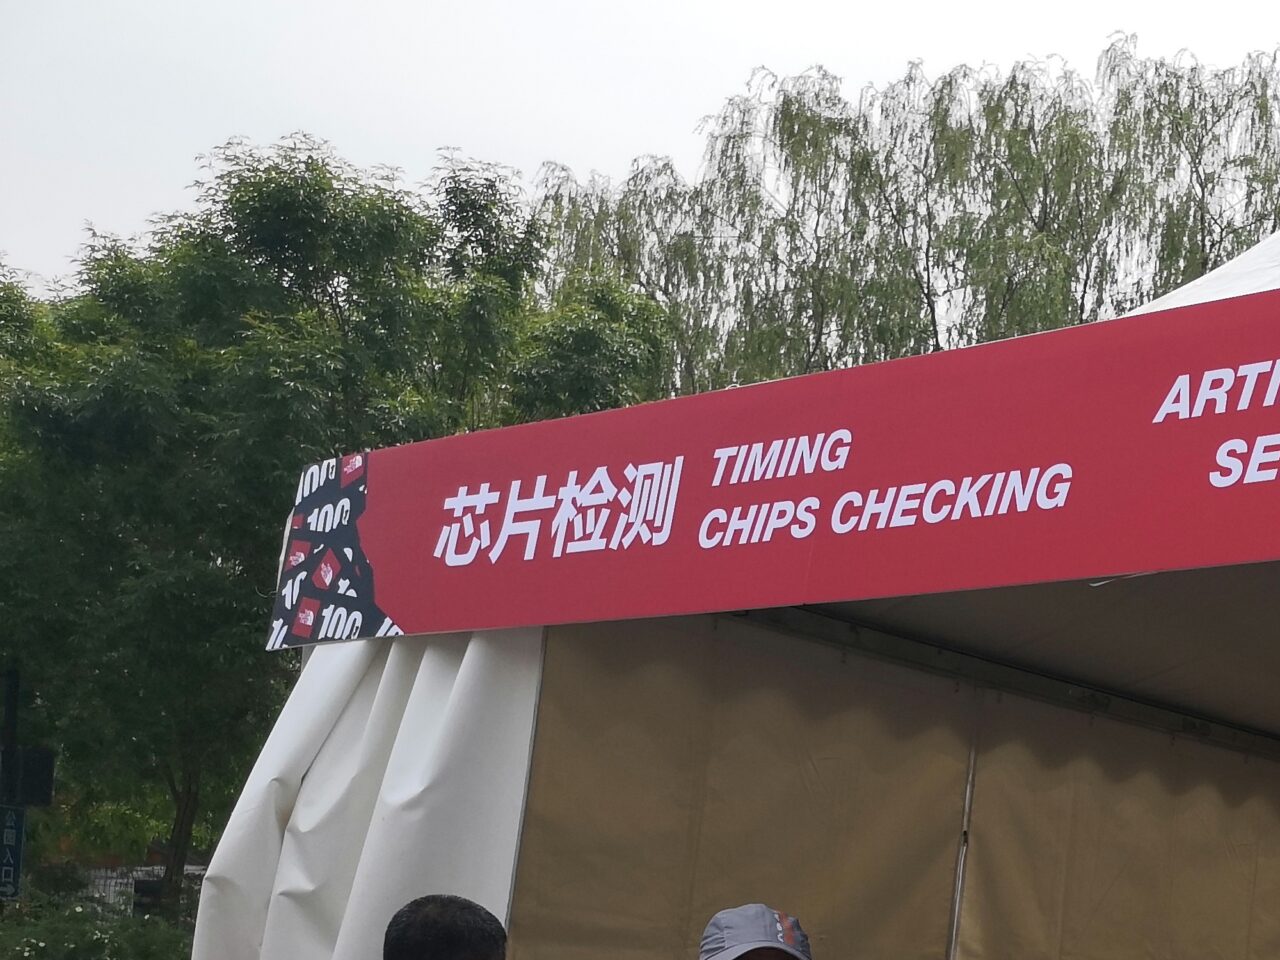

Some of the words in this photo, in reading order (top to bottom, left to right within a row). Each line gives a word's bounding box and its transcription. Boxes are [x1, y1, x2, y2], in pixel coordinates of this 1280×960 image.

[711, 429, 853, 487] TIMING
[307, 497, 351, 533] 100
[434, 455, 684, 567] 芯片检测
[698, 496, 822, 550] CHIPS
[830, 462, 1074, 535] CHECKING
[317, 604, 363, 641] 100
